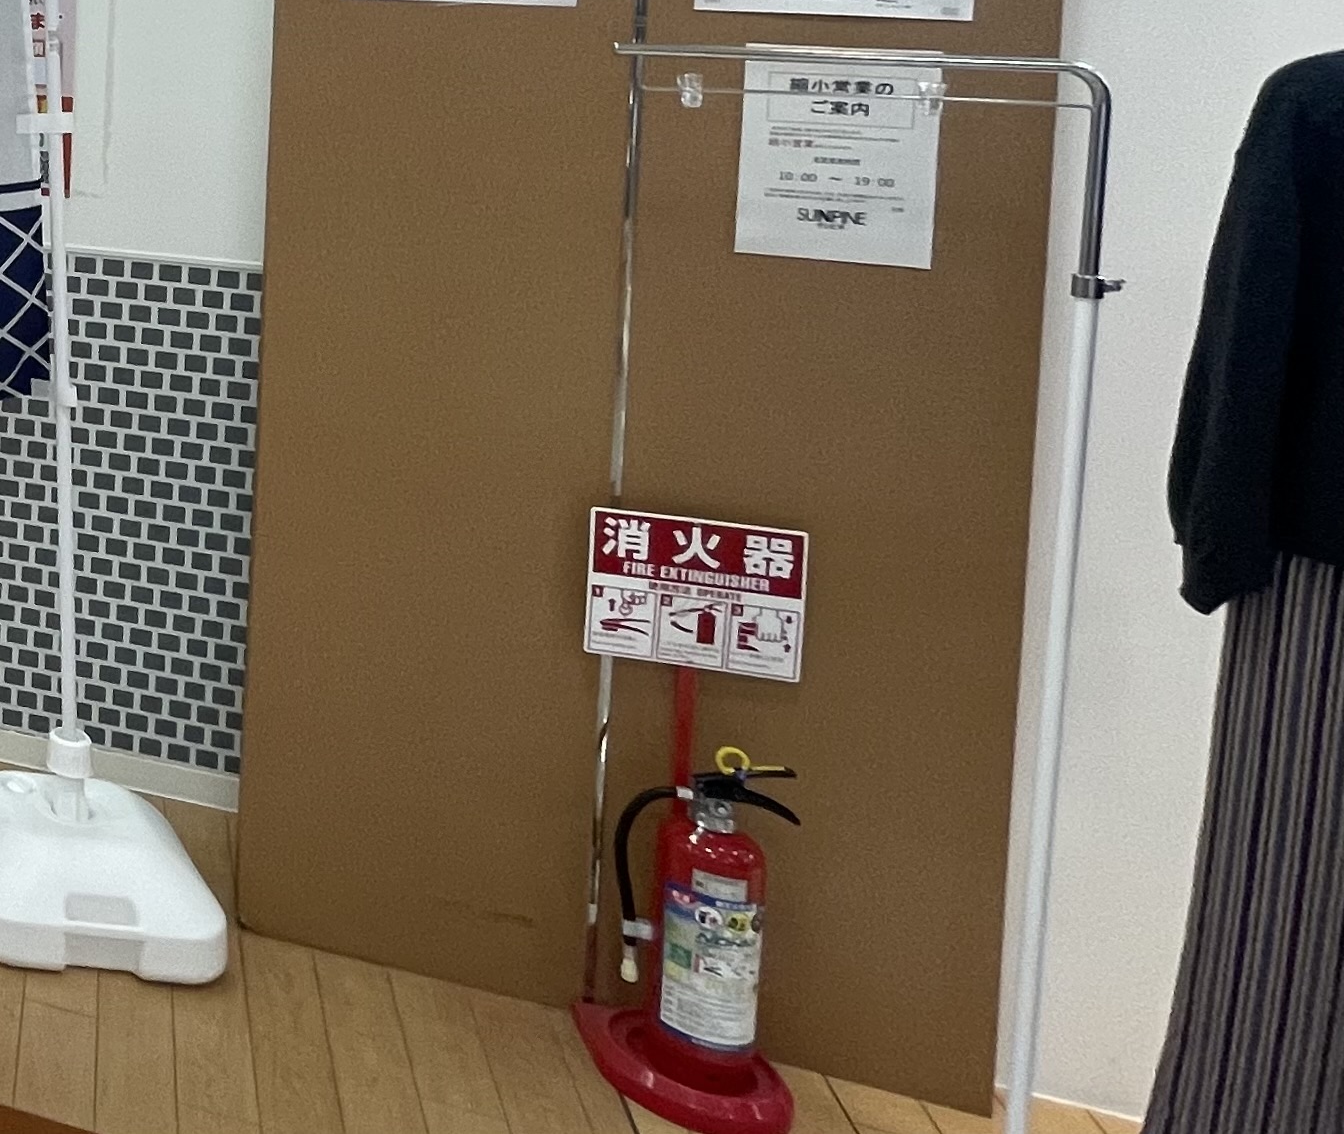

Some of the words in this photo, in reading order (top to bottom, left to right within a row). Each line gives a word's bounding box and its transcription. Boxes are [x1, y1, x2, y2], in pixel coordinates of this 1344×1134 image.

[811, 99, 871, 117] ご案内
[601, 516, 795, 579] 消火器
[622, 560, 656, 578] FIRE
[660, 565, 771, 592] EXTINGUISHER
